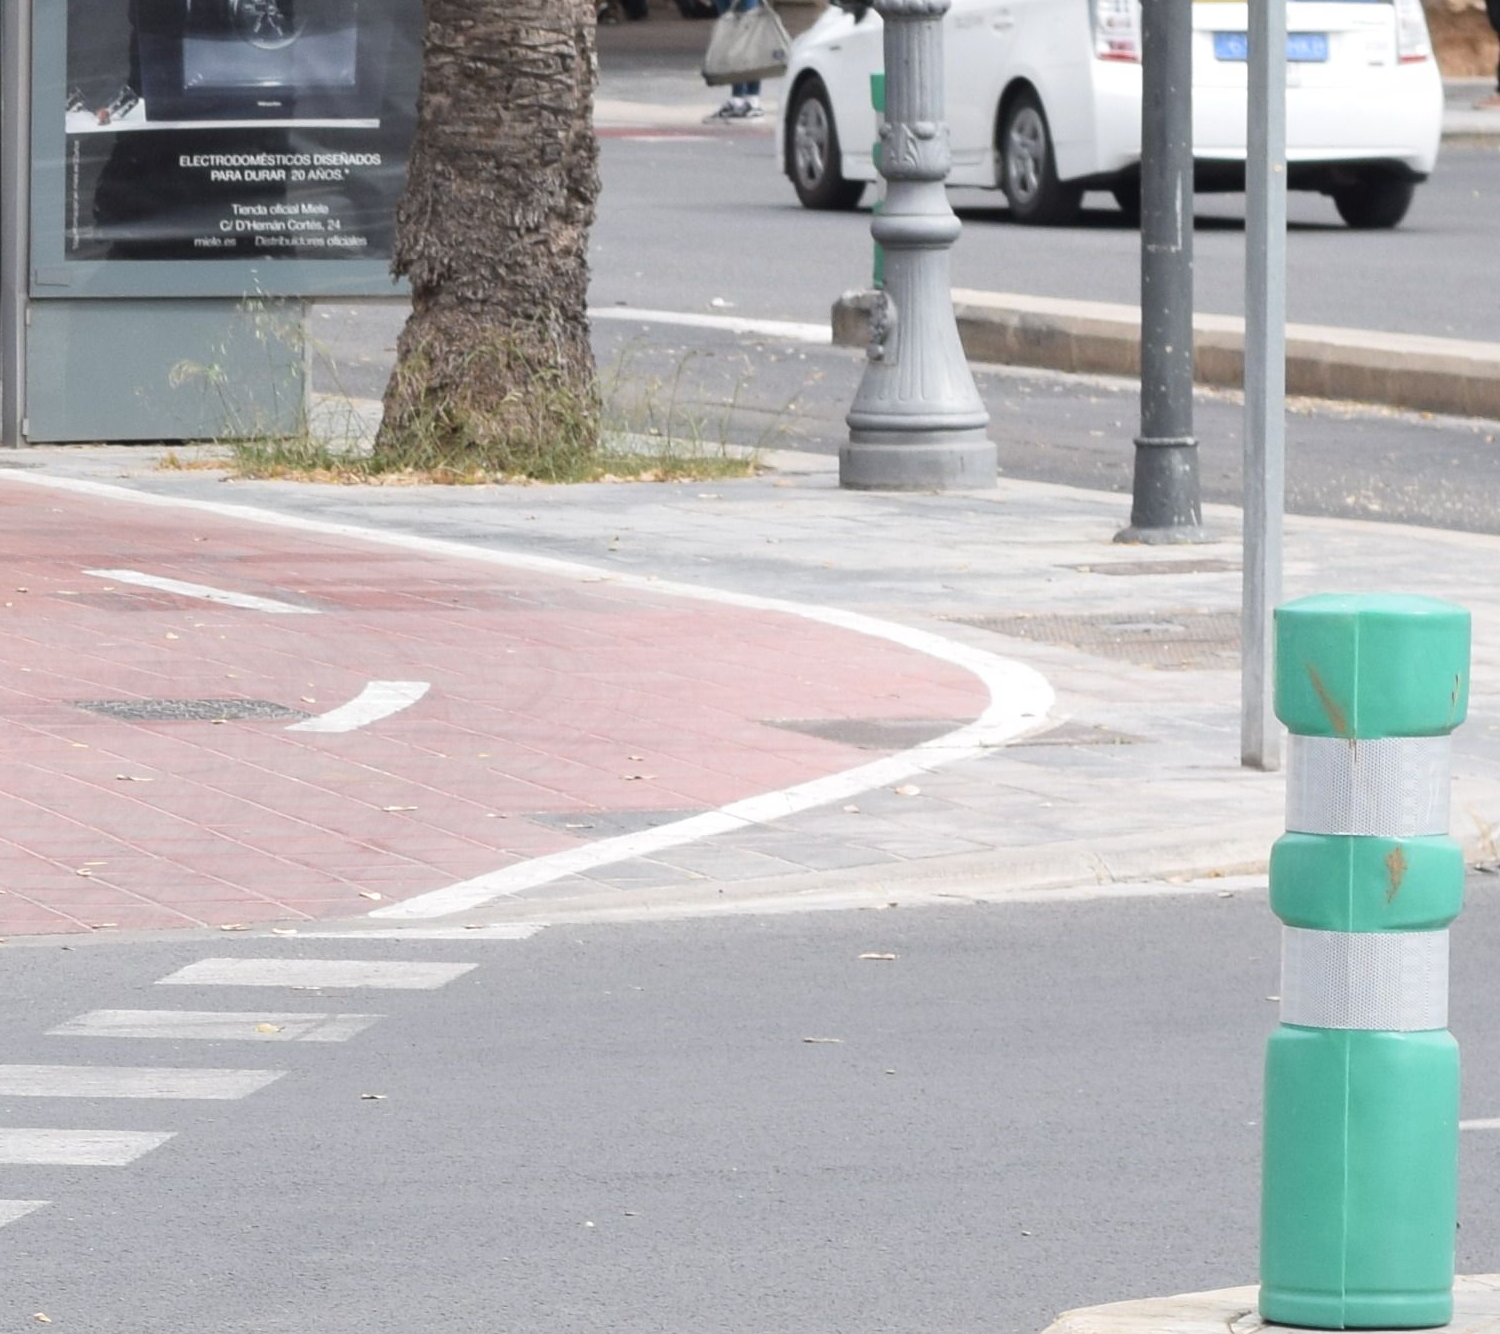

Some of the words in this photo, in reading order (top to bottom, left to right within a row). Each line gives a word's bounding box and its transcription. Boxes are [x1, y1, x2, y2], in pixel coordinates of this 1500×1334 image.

[179, 153, 311, 167] ELECTRODOMÉSTICOS
[313, 152, 381, 166] DISEÑADOS
[211, 170, 242, 182] PARA
[244, 169, 286, 182] DURAR
[291, 169, 305, 181] 20
[231, 203, 268, 216] Tienda
[269, 203, 299, 215] oficial
[301, 203, 330, 215] Miele
